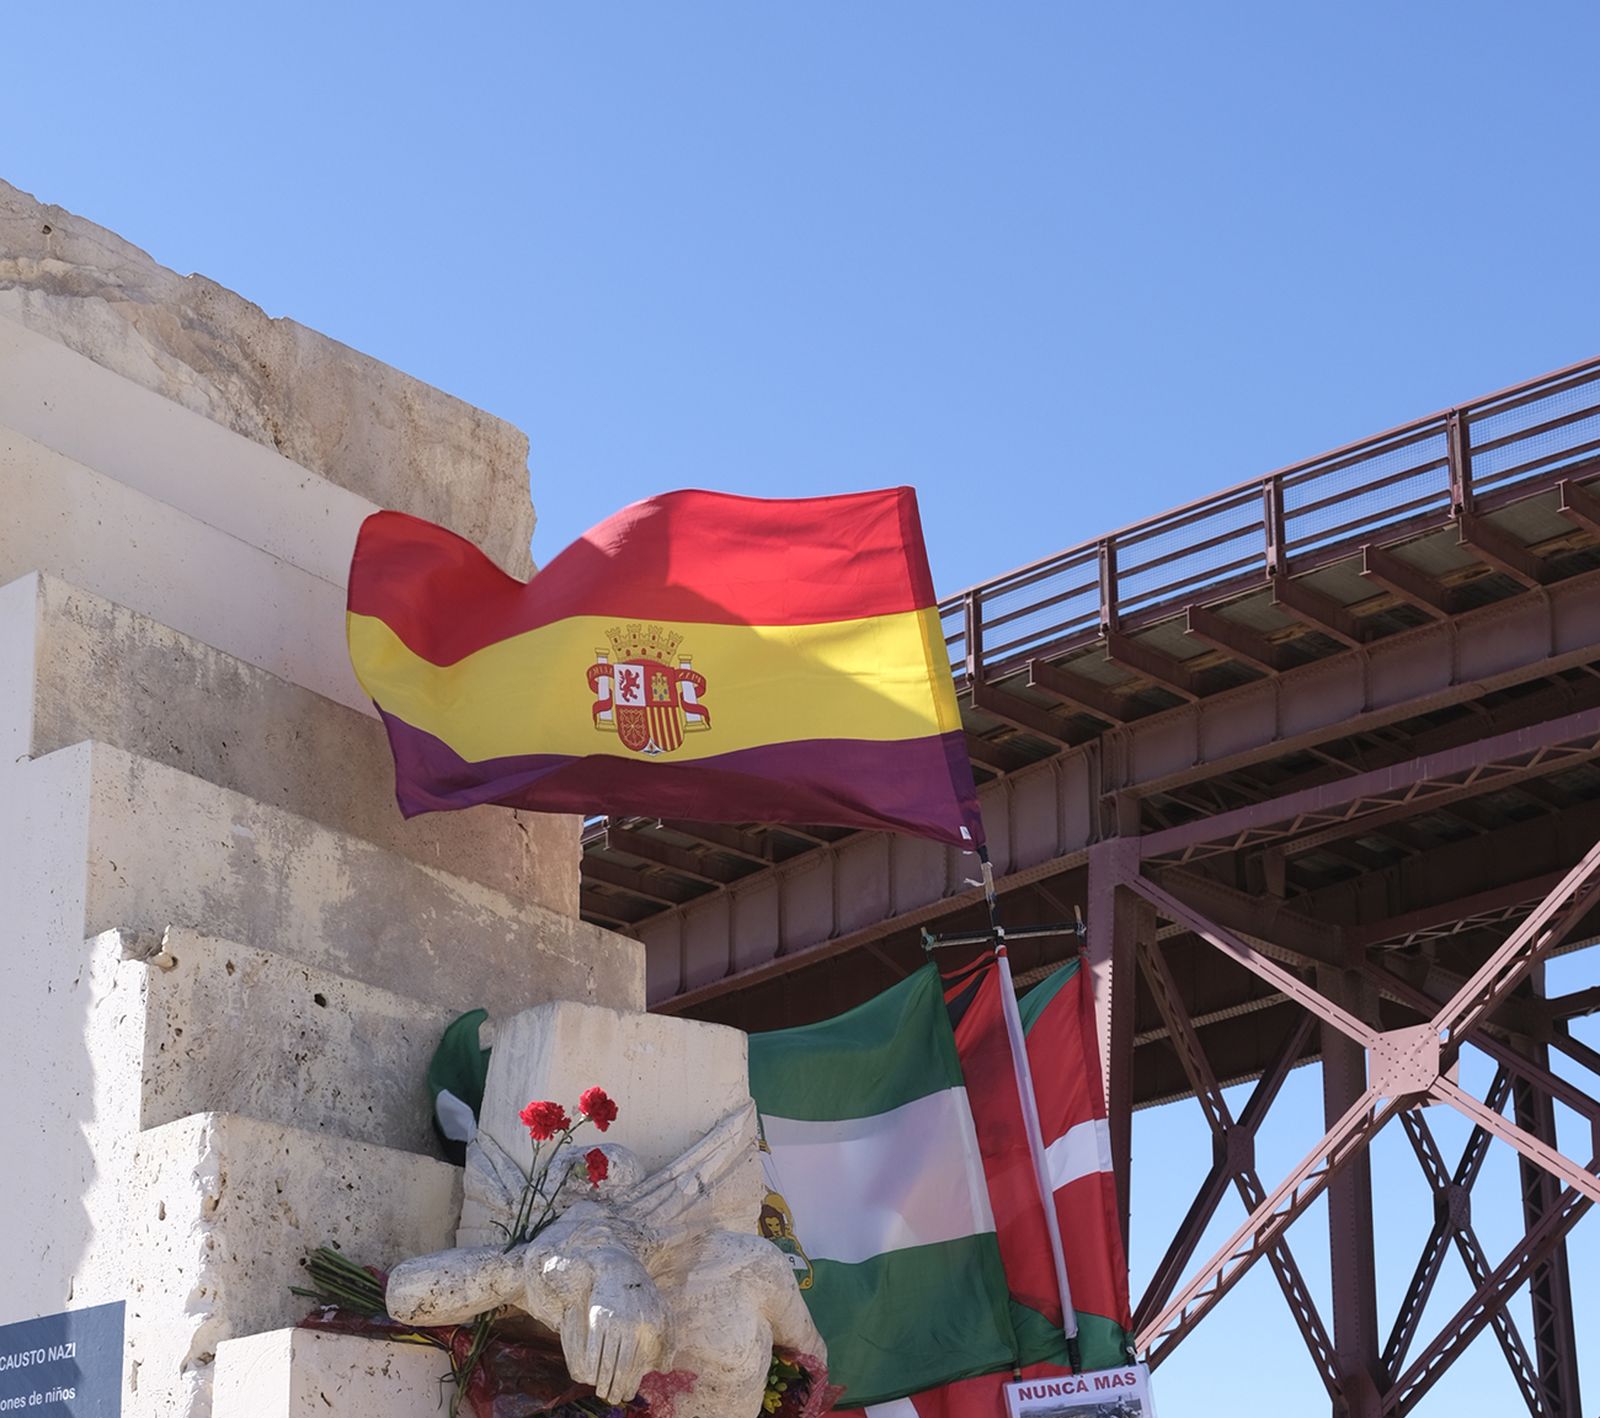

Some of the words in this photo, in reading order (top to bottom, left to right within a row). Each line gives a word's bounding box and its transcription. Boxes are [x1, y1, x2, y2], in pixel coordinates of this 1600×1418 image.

[0, 1349, 46, 1371] CAUSTO
[48, 1342, 77, 1361] NAZI
[0, 1397, 27, 1412] ones
[29, 1390, 43, 1406] de
[45, 1386, 77, 1402] niños
[1018, 1380, 1089, 1401] NUNCA
[1094, 1372, 1137, 1391] MAS
